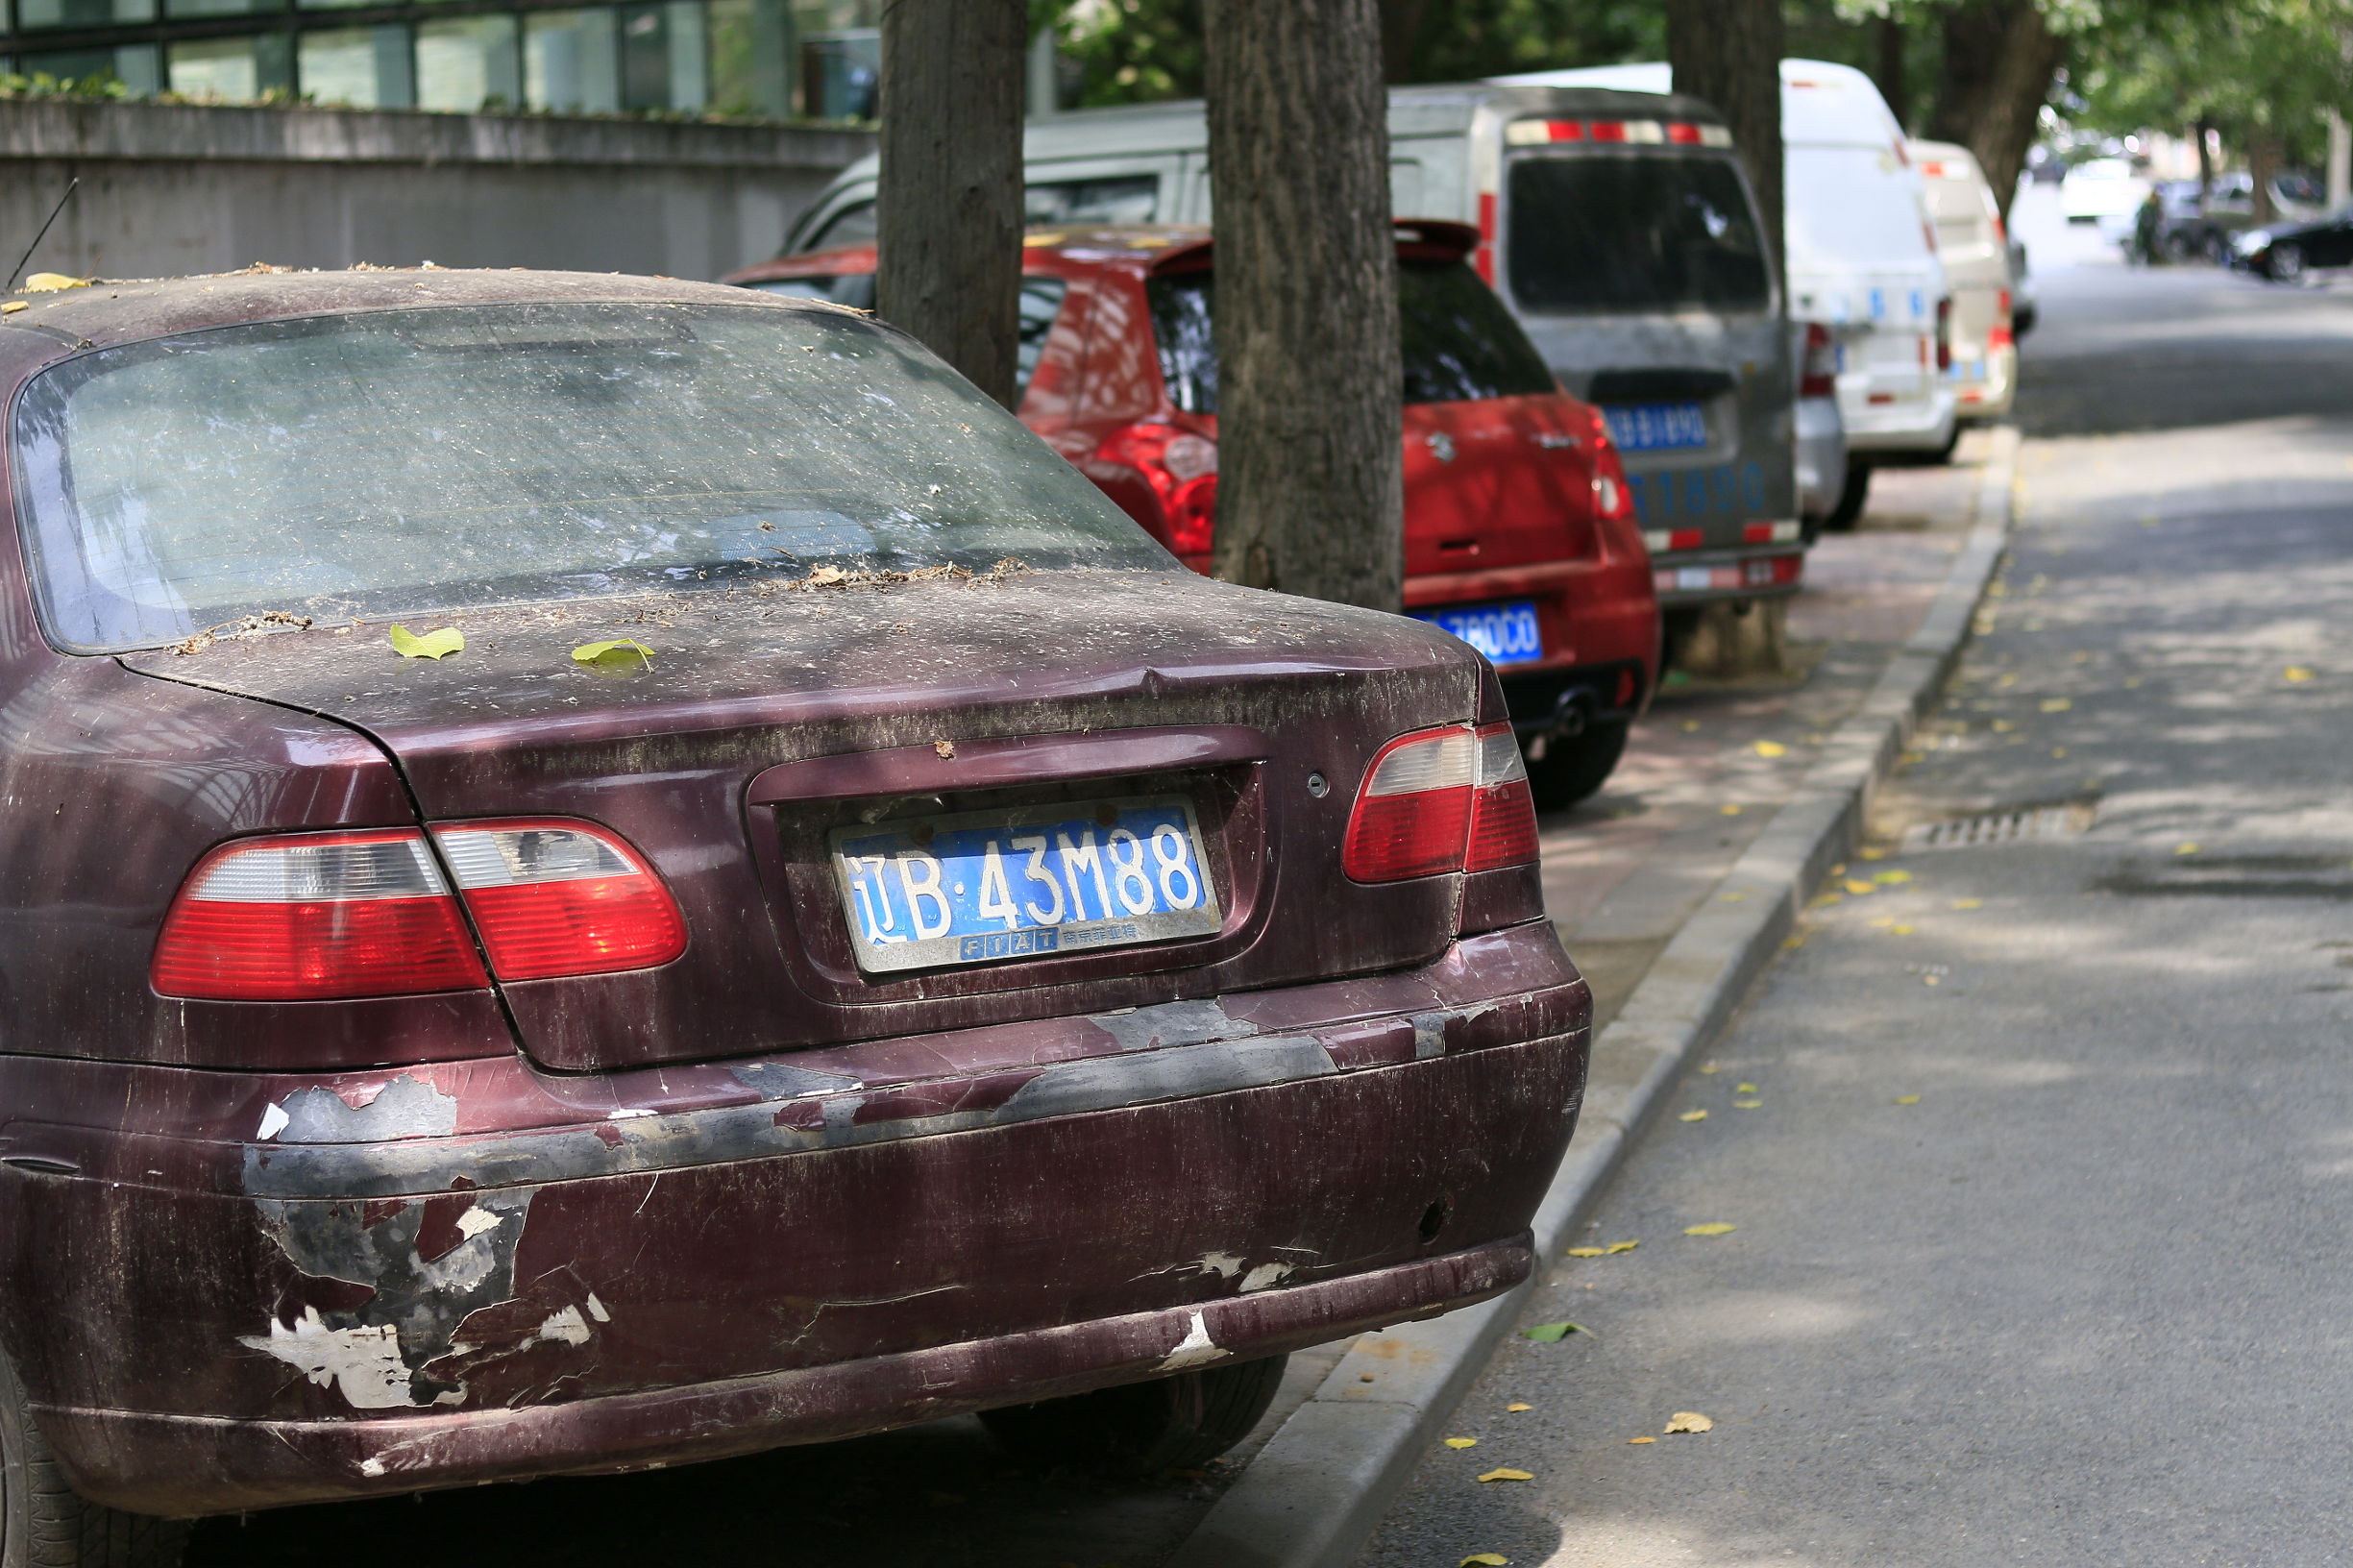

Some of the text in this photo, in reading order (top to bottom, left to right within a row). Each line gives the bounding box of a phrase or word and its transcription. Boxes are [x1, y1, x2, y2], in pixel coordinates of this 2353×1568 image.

[965, 923, 1137, 956] FIAT 南京菲亚特
